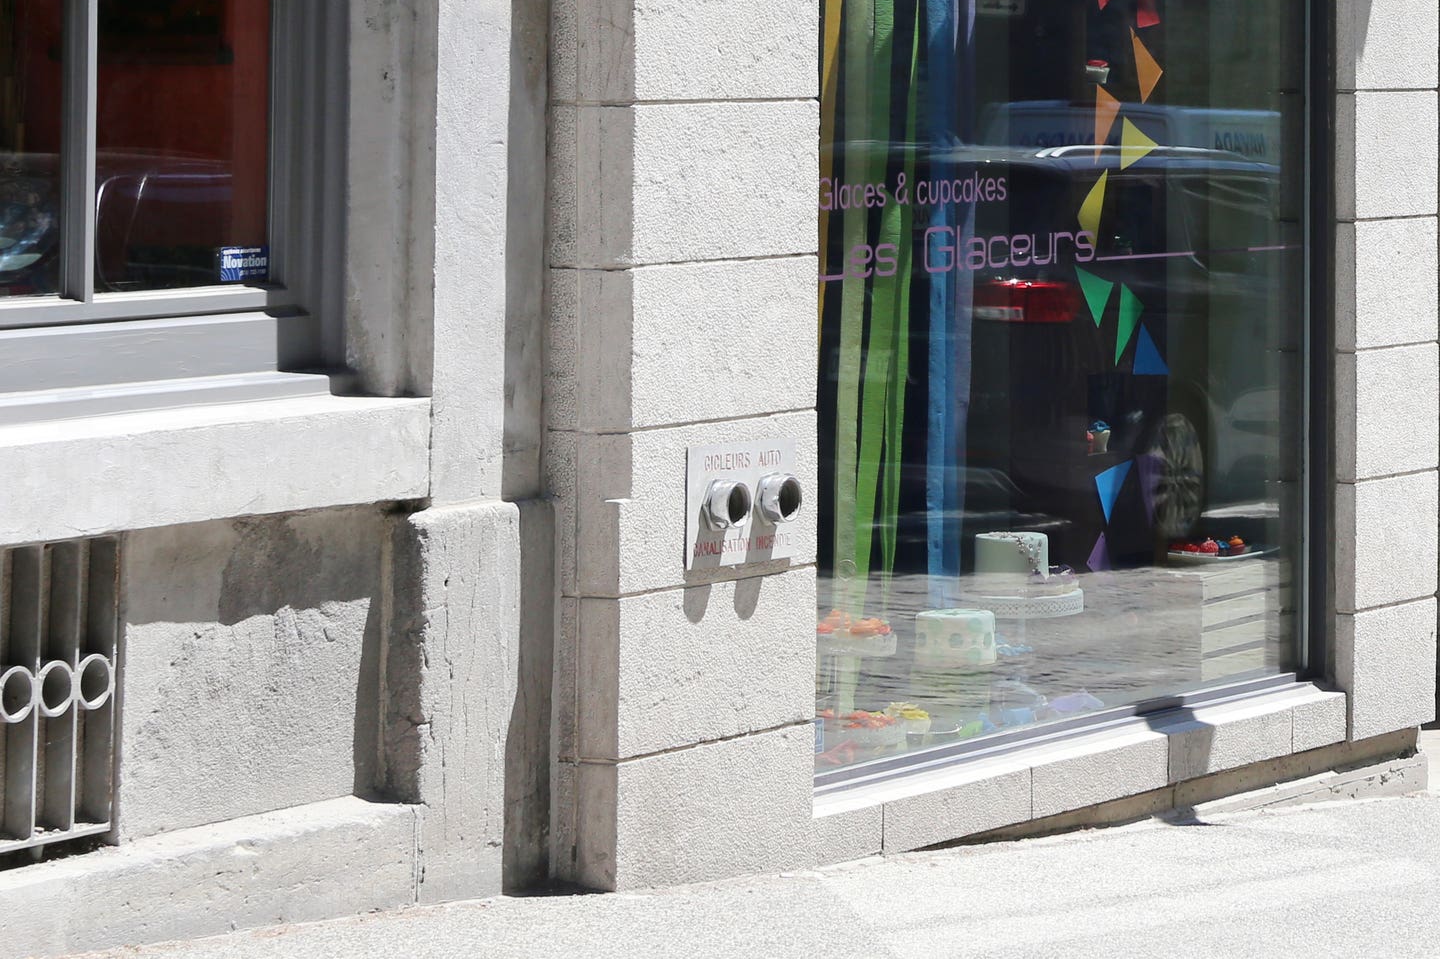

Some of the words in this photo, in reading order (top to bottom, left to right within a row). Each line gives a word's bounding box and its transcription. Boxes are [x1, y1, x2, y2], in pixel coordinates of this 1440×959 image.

[819, 175, 886, 211] Glaces
[895, 171, 909, 205] &
[916, 170, 1007, 209] cupcakes
[223, 254, 267, 269] Novation
[924, 224, 1097, 274] Glaceurs
[704, 452, 750, 472] GICLEURS
[759, 450, 781, 466] AUTO
